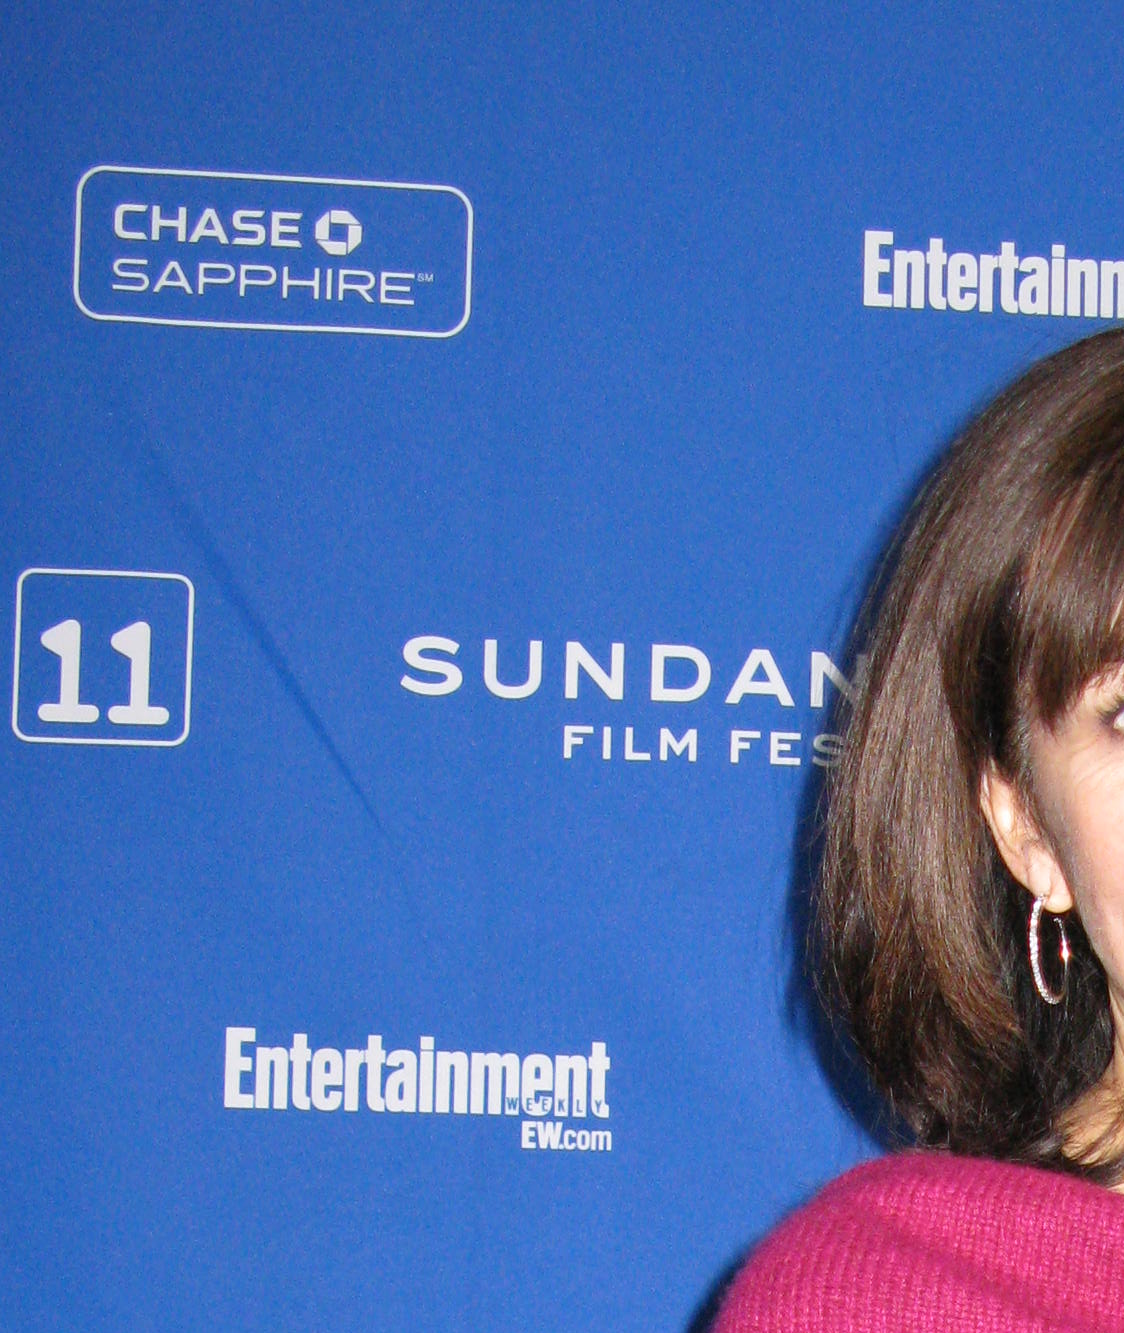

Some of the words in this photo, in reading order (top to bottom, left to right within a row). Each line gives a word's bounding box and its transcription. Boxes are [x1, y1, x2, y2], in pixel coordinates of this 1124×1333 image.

[113, 203, 303, 248] CHASE
[112, 258, 415, 305] SAPPHIRE
[38, 619, 170, 725] 11
[562, 725, 698, 763] FILM
[224, 1027, 610, 1118] Entertainment
[506, 1097, 602, 1113] WEEKLY
[521, 1121, 613, 1152] EW.com
